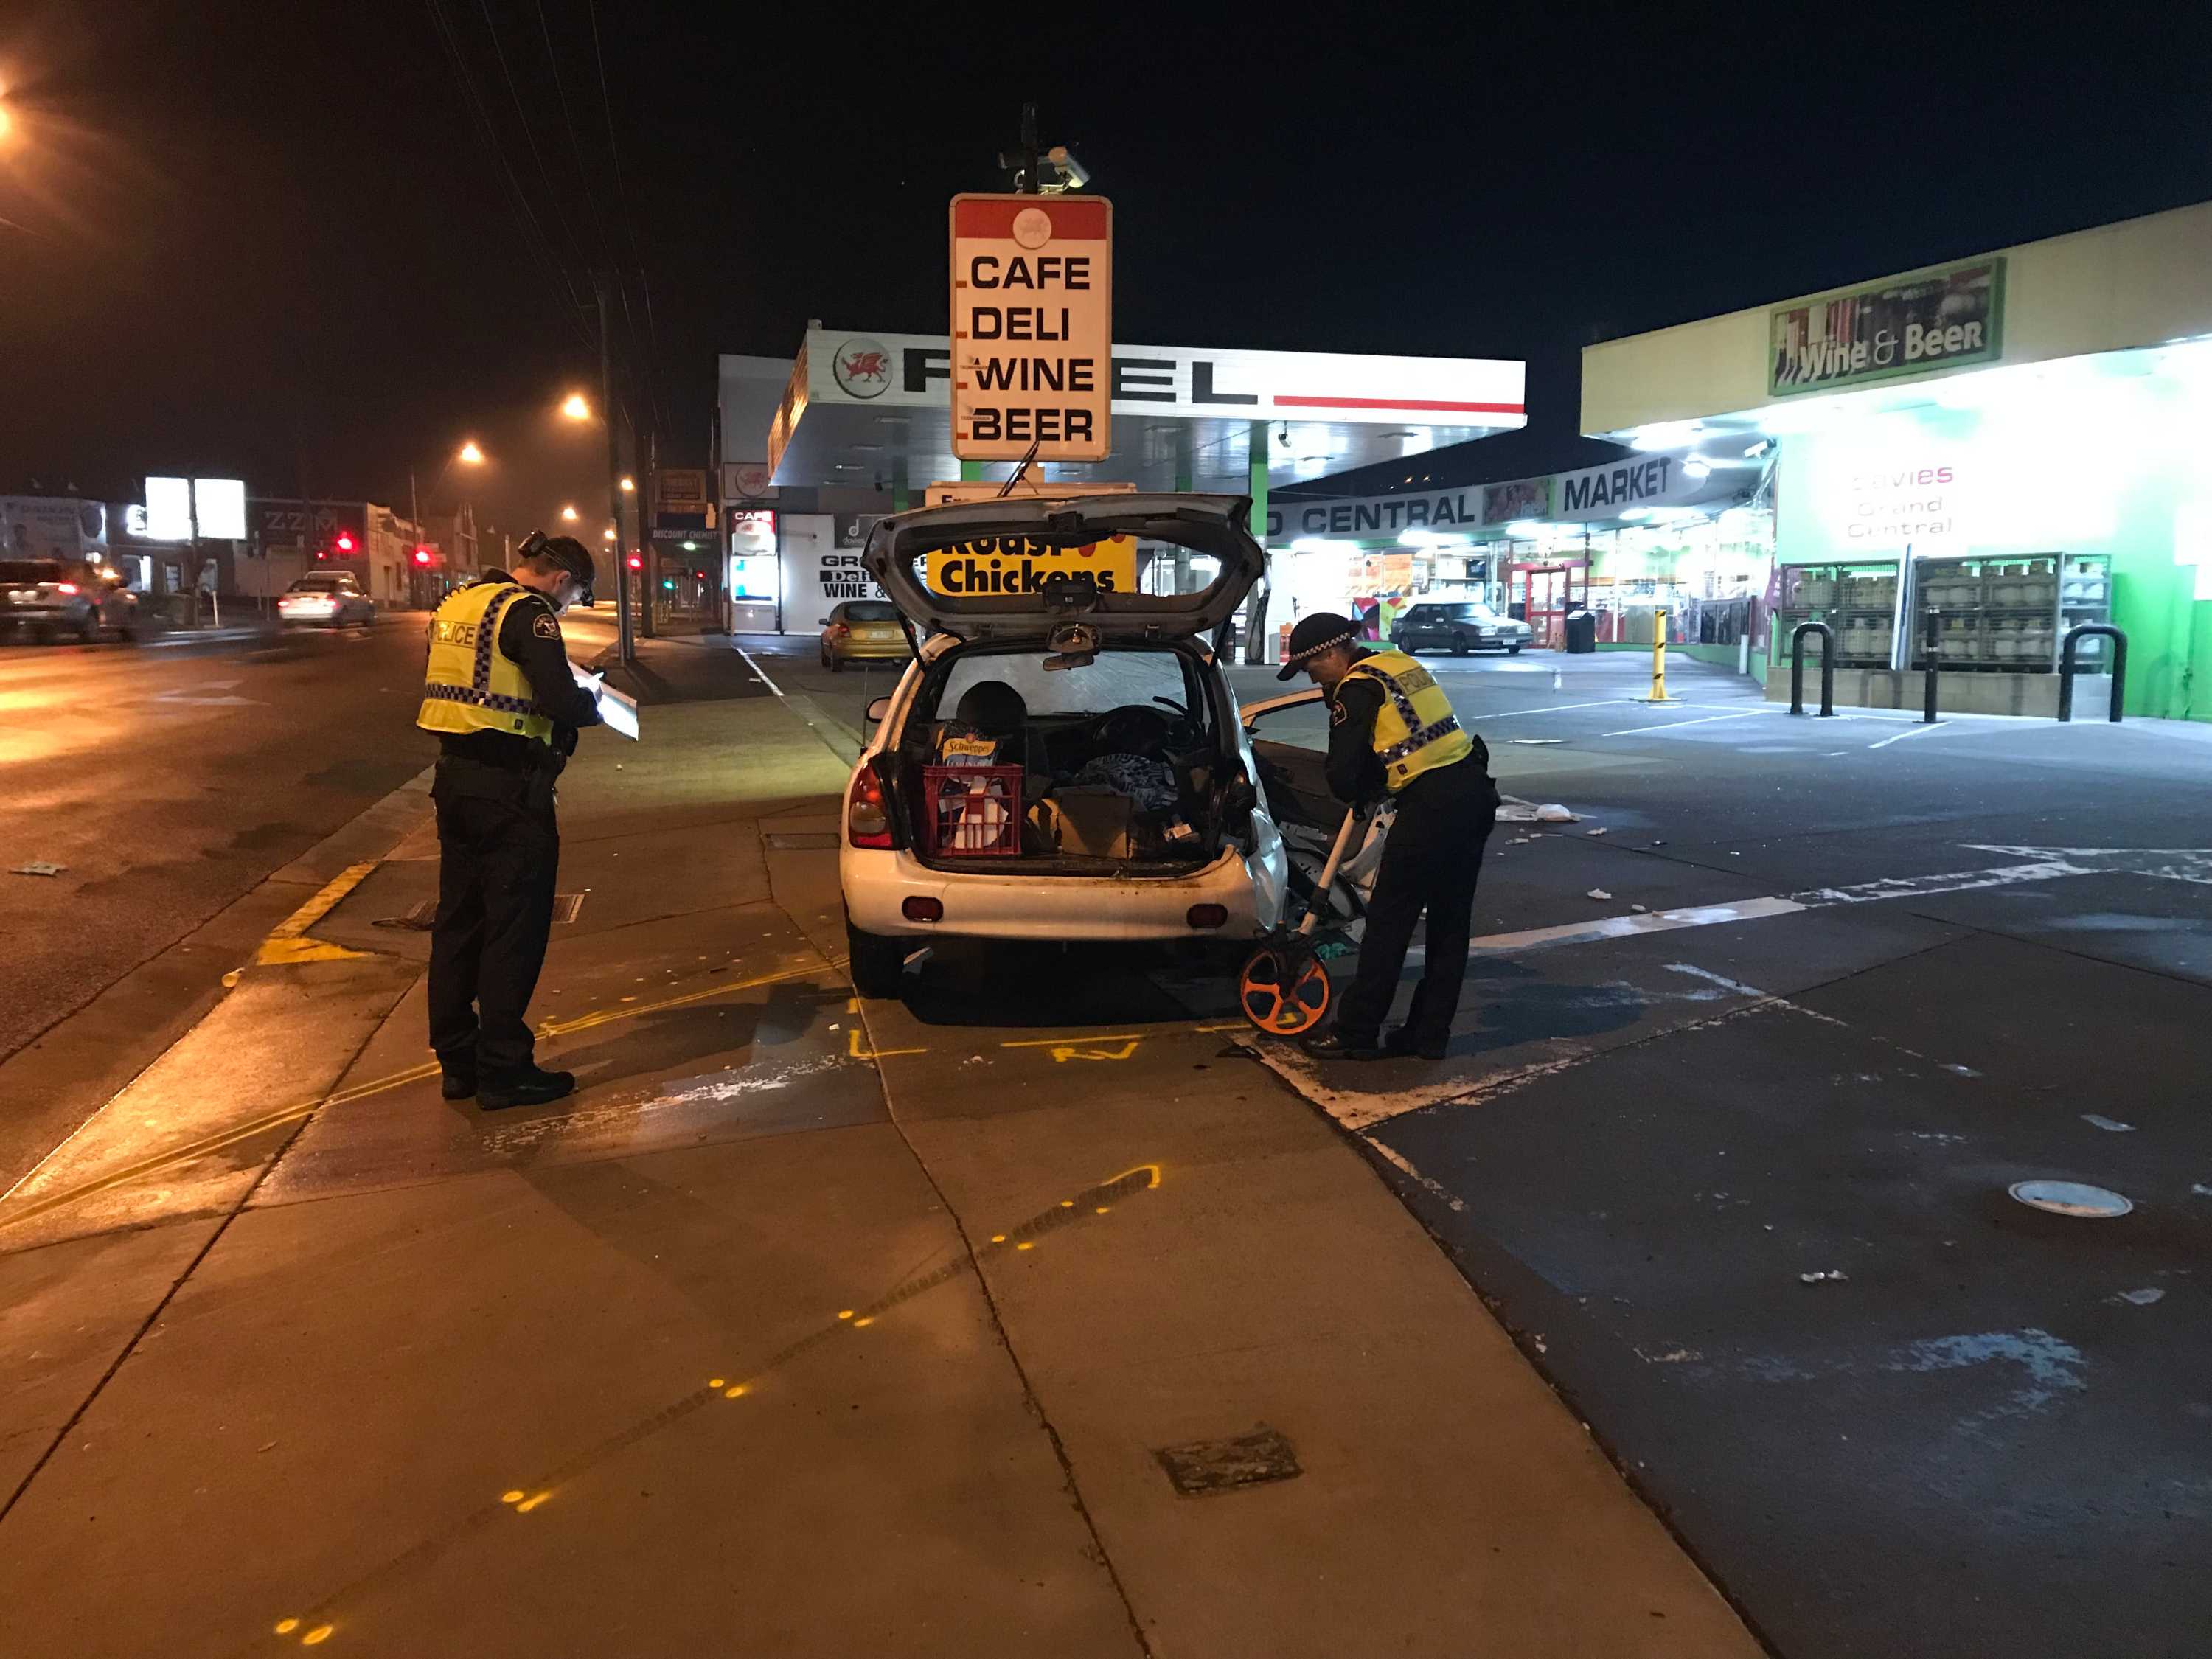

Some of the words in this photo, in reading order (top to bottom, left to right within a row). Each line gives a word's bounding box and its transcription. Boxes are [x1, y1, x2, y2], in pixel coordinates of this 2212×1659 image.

[971, 256, 1091, 290] CAFE
[972, 307, 1070, 341] DELI
[974, 358, 1094, 392] WINE
[973, 408, 1093, 442] BEER
[1302, 495, 1475, 534] CENTRAL
[1564, 457, 1672, 512] MARKET
[653, 529, 687, 539] DISCOUNT
[824, 583, 867, 598] WINE
[875, 584, 886, 598] &
